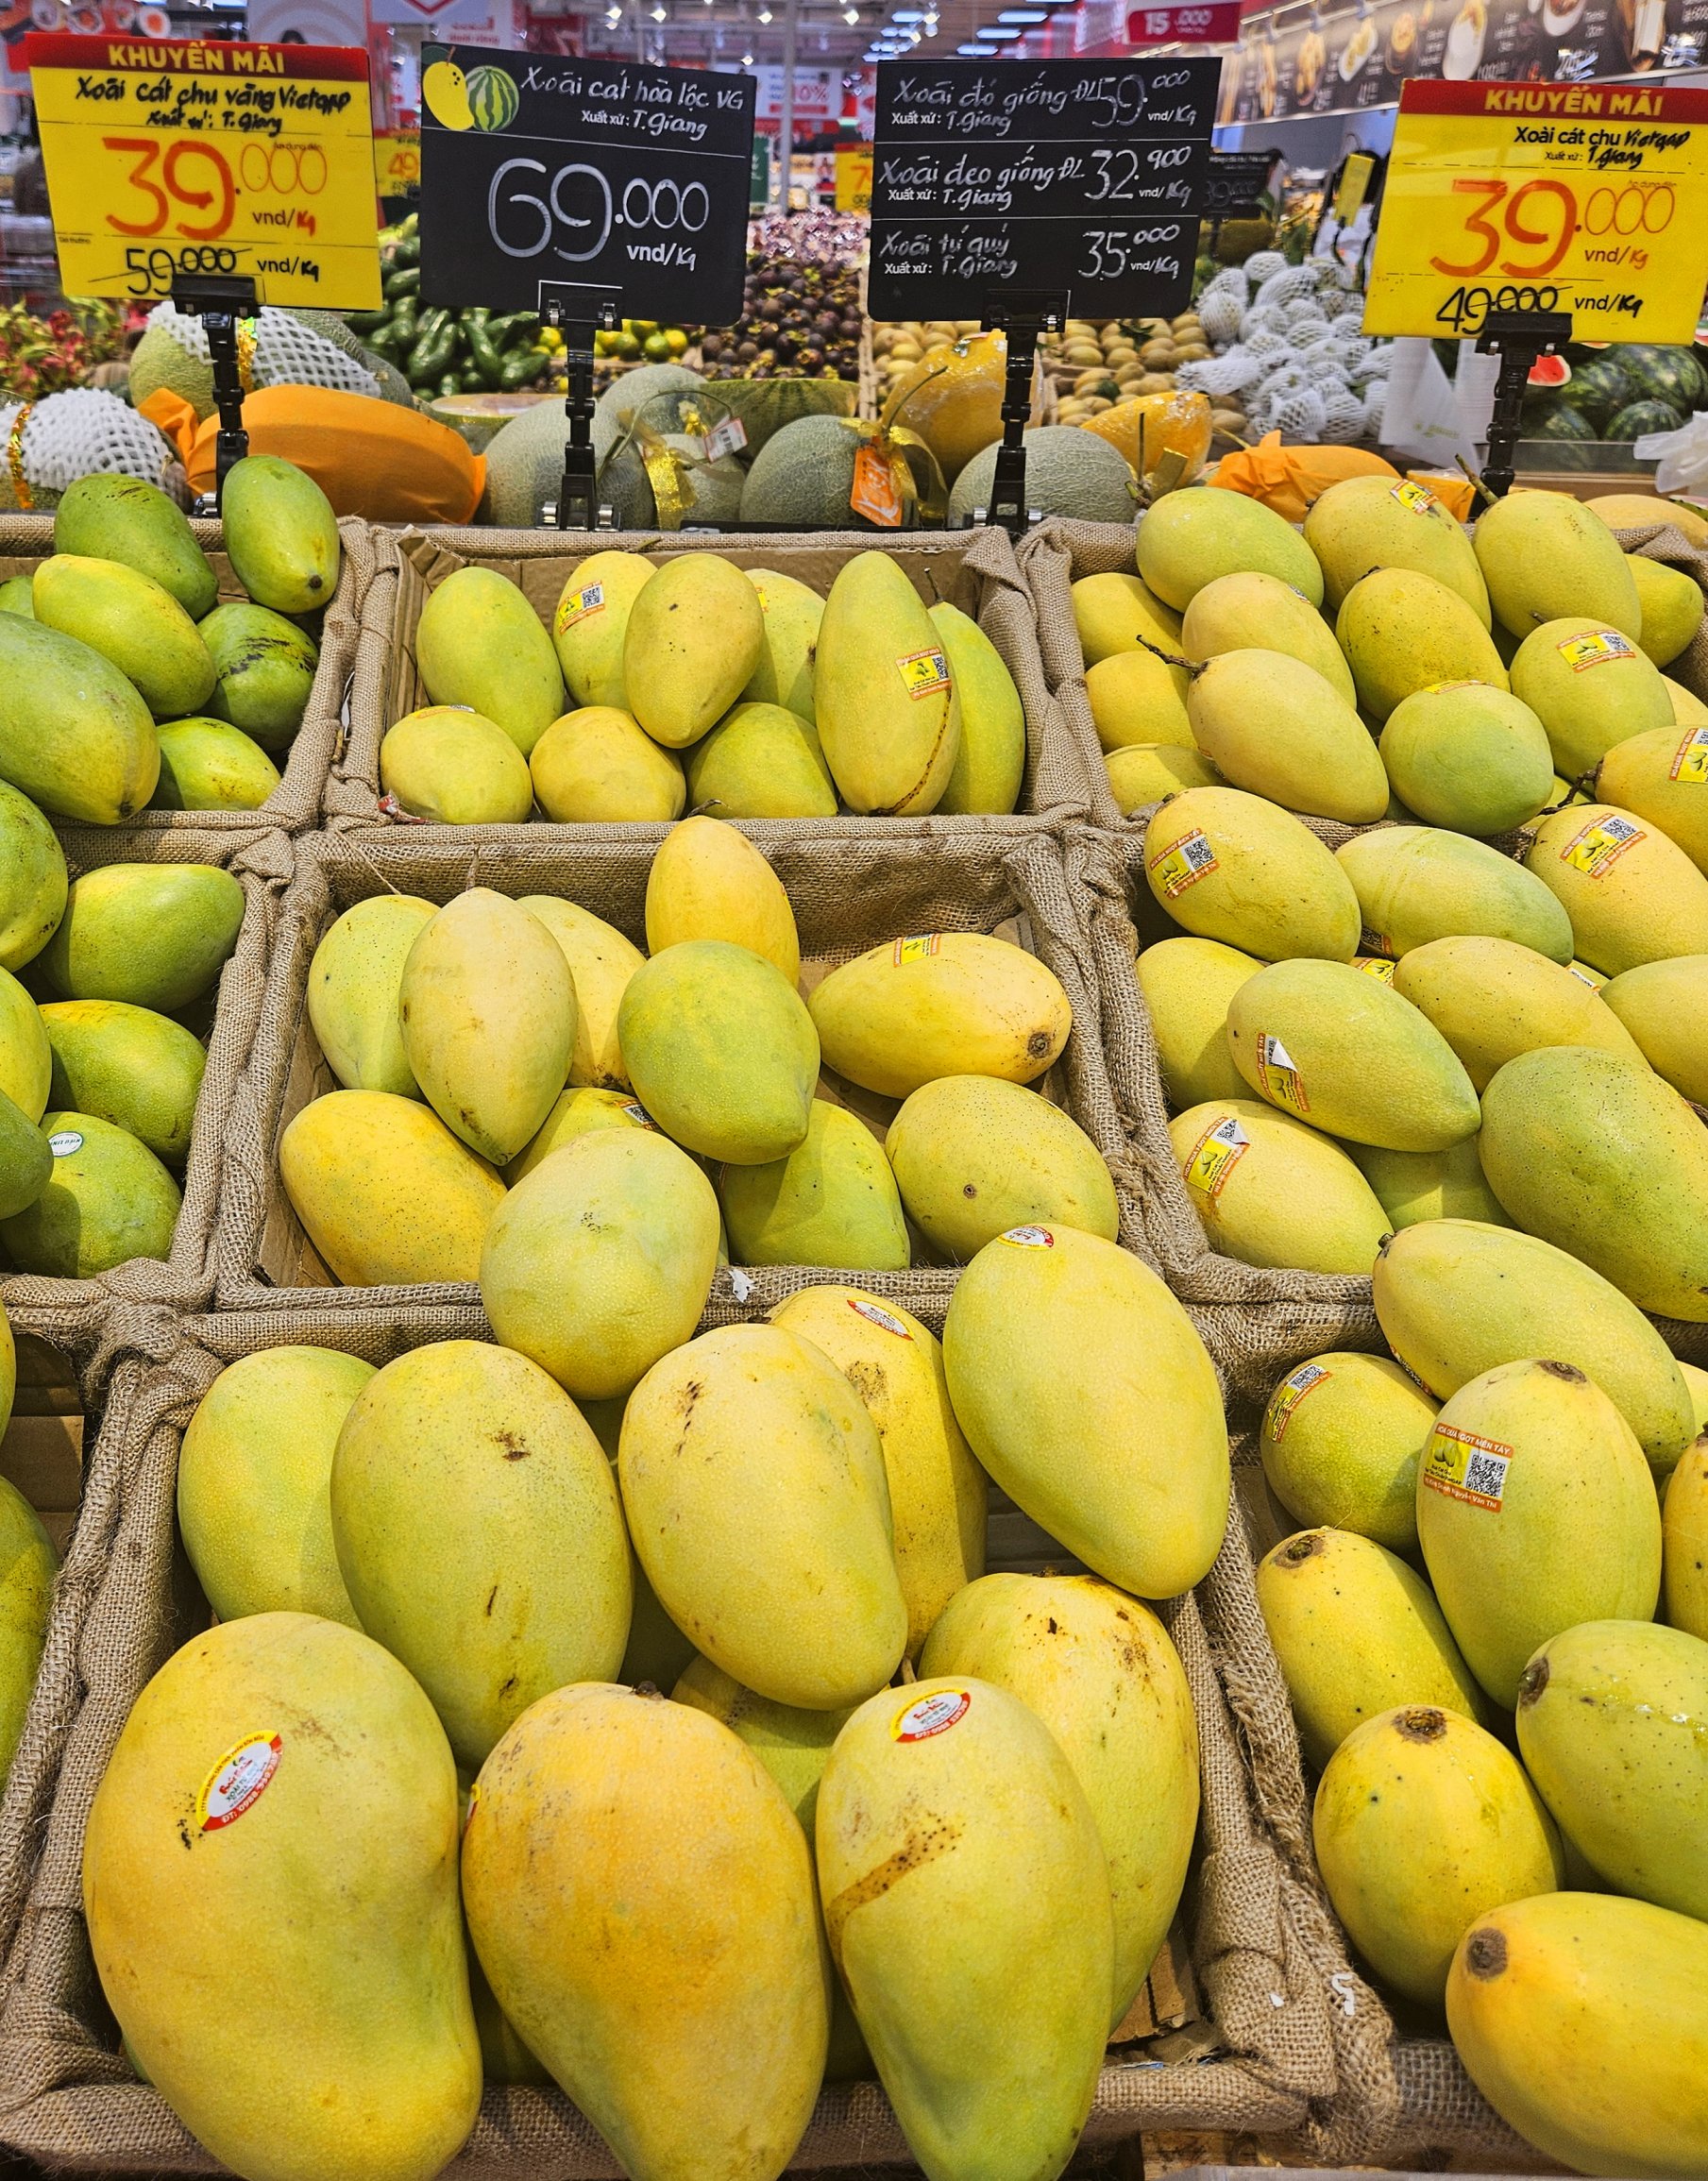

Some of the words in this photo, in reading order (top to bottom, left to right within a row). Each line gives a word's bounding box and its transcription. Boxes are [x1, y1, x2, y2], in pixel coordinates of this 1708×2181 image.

[108, 42, 225, 72] KHUYẾN
[233, 44, 284, 74] MÃI
[717, 90, 744, 110] VG
[1484, 85, 1602, 114] KHUYẾN
[1608, 89, 1665, 116] MÃI
[582, 110, 608, 125] Xuất
[891, 112, 919, 125] Xuất
[1514, 126, 1555, 144] Xoài
[1558, 127, 1585, 144] cát
[1589, 128, 1622, 145] chu
[888, 188, 915, 202] Xuất
[488, 158, 710, 262] 69.000
[884, 261, 911, 275] Xuất
